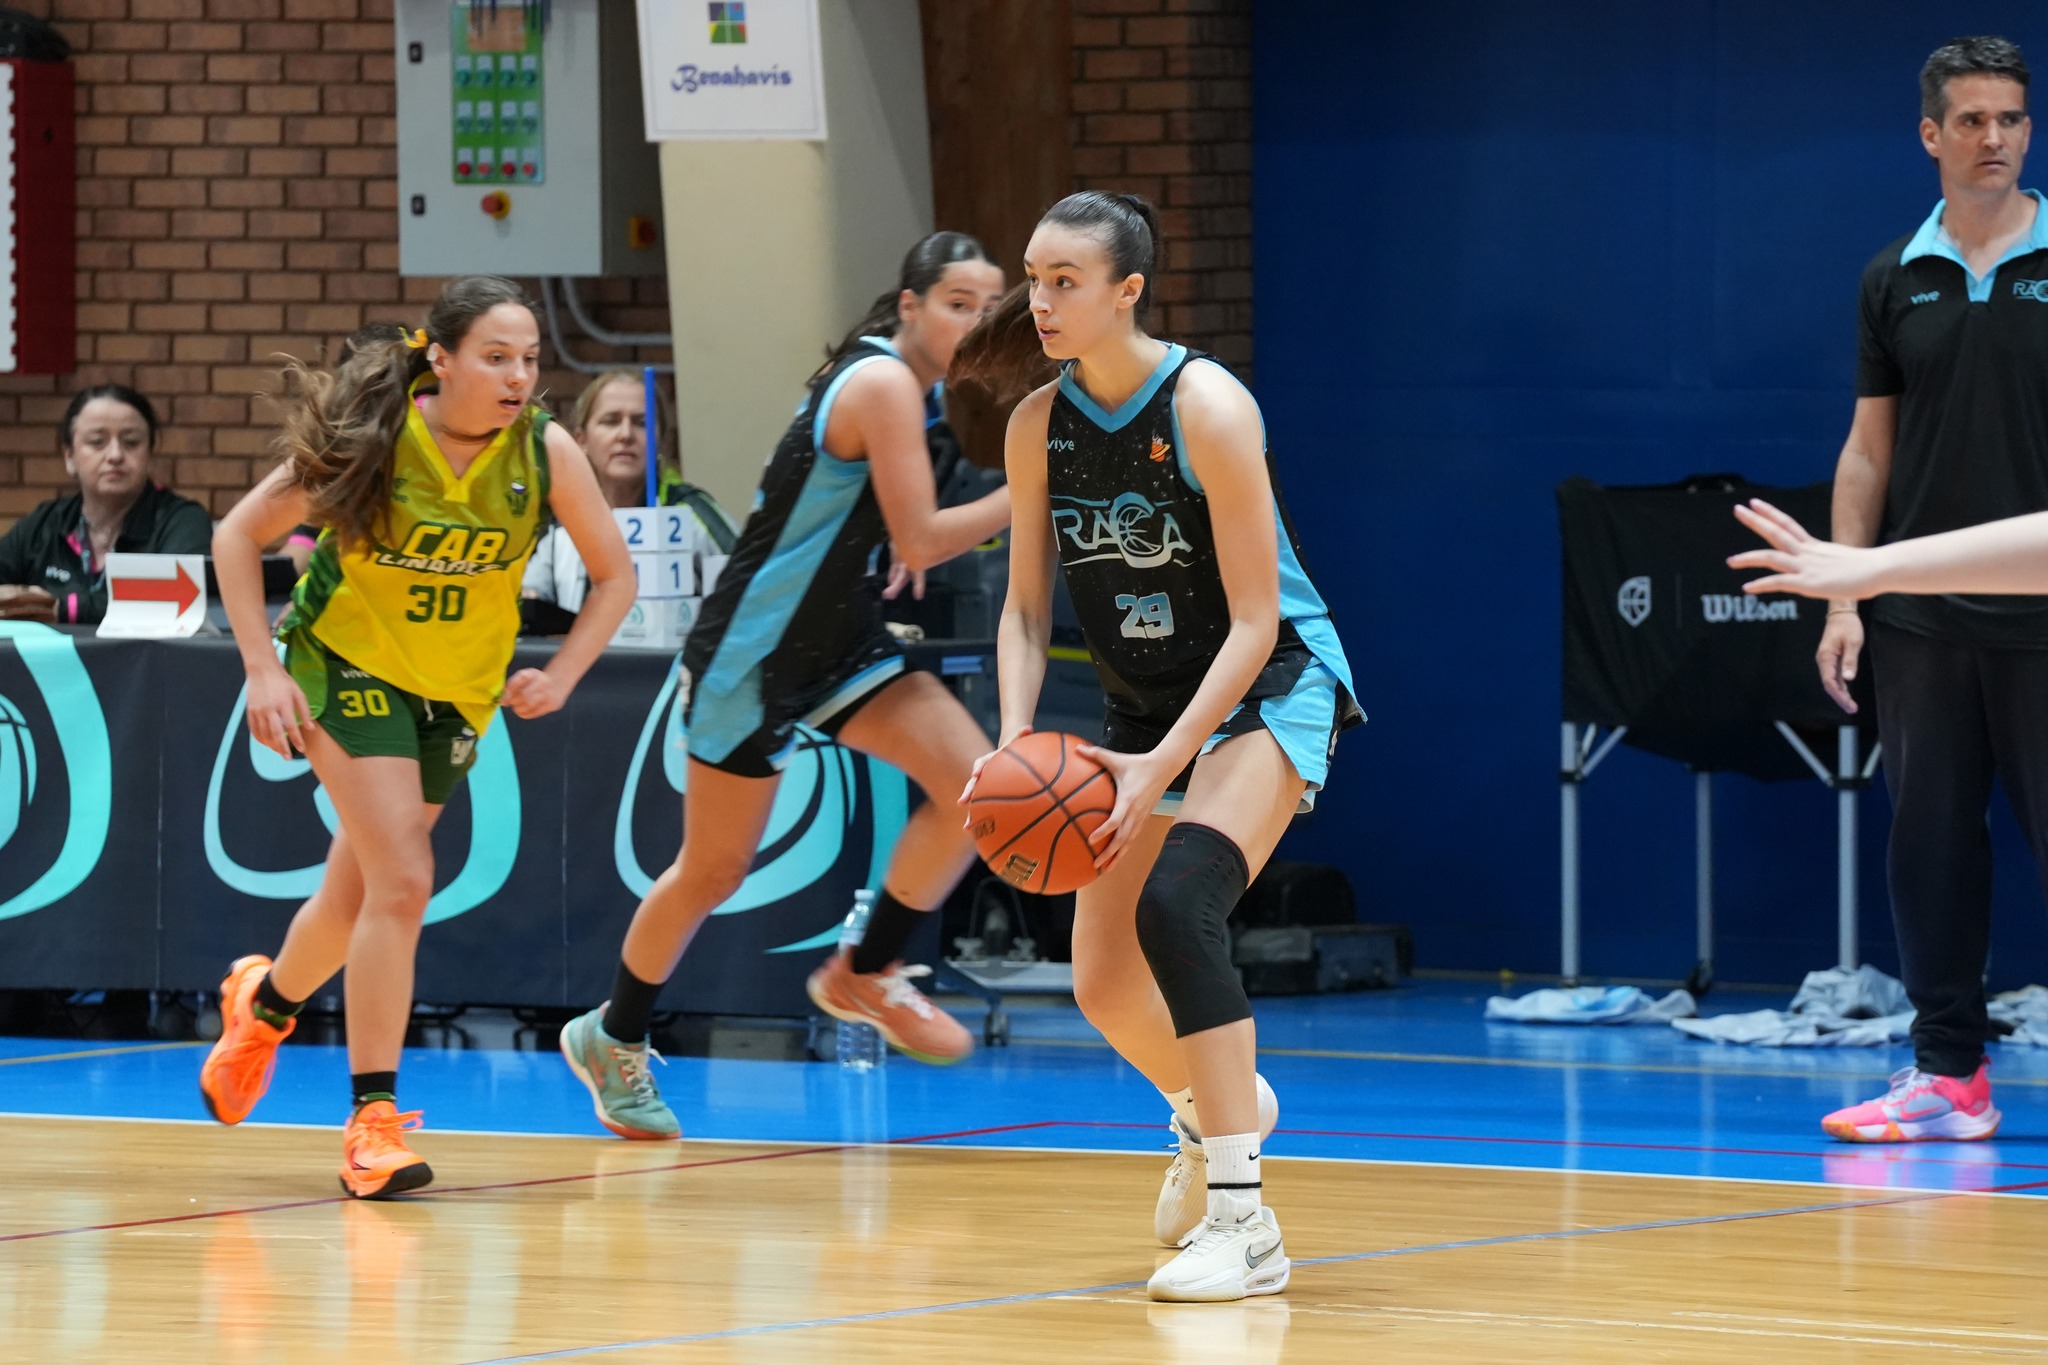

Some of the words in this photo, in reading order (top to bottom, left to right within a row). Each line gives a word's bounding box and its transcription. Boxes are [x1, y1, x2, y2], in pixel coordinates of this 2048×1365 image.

[670, 63, 792, 93] Benahavís
[1046, 438, 1075, 451] vive
[401, 522, 507, 564] CAB
[627, 517, 643, 544] 2
[668, 516, 682, 543] 2
[1051, 491, 1194, 569] RACA
[670, 561, 681, 589] 1
[406, 584, 467, 622] 30
[1114, 591, 1175, 639] 29
[1701, 593, 1799, 623] Wilson
[337, 688, 391, 718] 30
